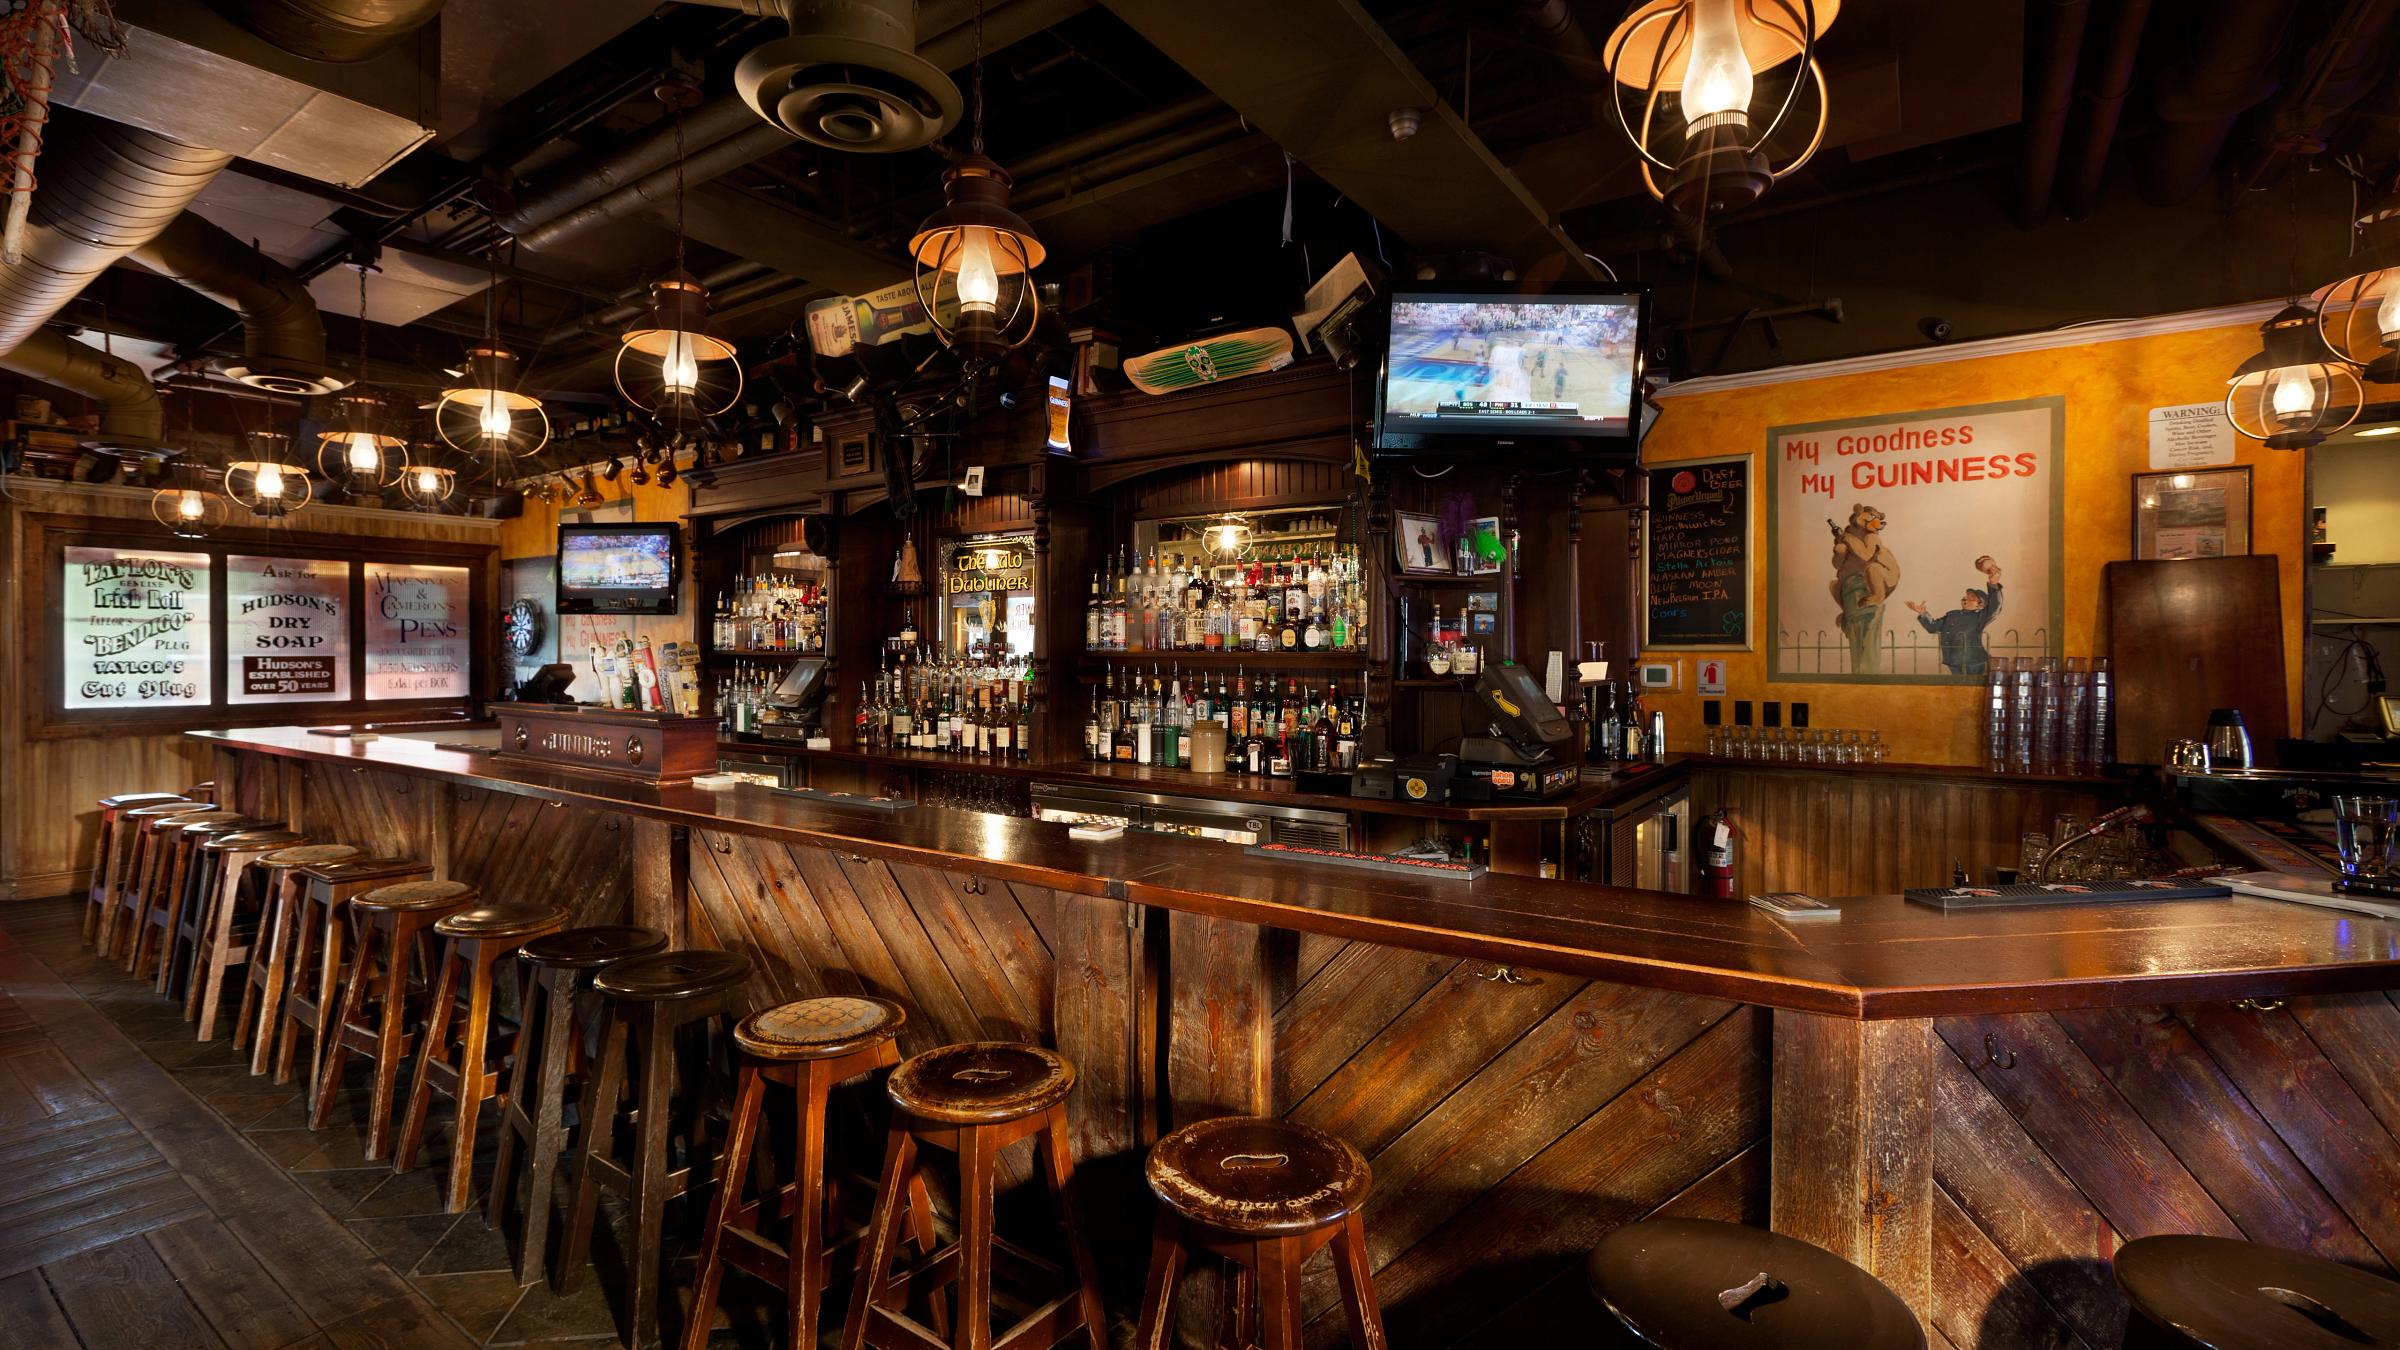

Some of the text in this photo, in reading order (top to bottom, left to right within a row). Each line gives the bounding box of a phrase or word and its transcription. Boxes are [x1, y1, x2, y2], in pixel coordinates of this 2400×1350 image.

[876, 292, 896, 302] TASTE
[2164, 406, 2220, 418] WARNING:
[1786, 425, 1974, 466] My Goodness
[1802, 452, 2037, 499] My GUINNESS
[956, 554, 985, 572] The
[83, 558, 194, 589] TAYLOR'S
[94, 588, 184, 610] Irish Roll
[416, 588, 427, 600] &
[242, 594, 336, 616] HUDSON'S
[1652, 608, 1688, 618] Coors
[268, 616, 312, 628] DRY
[400, 618, 456, 643] PENS
[155, 640, 190, 650] PLUG
[256, 635, 324, 648] SOAP
[994, 642, 1015, 654] PUB
[94, 660, 184, 674] TAYLOR'S
[257, 658, 322, 670] HUDSON'S
[249, 672, 331, 680] ESTABLISHED
[82, 680, 196, 698] Cut Plug
[278, 680, 299, 692] 50
